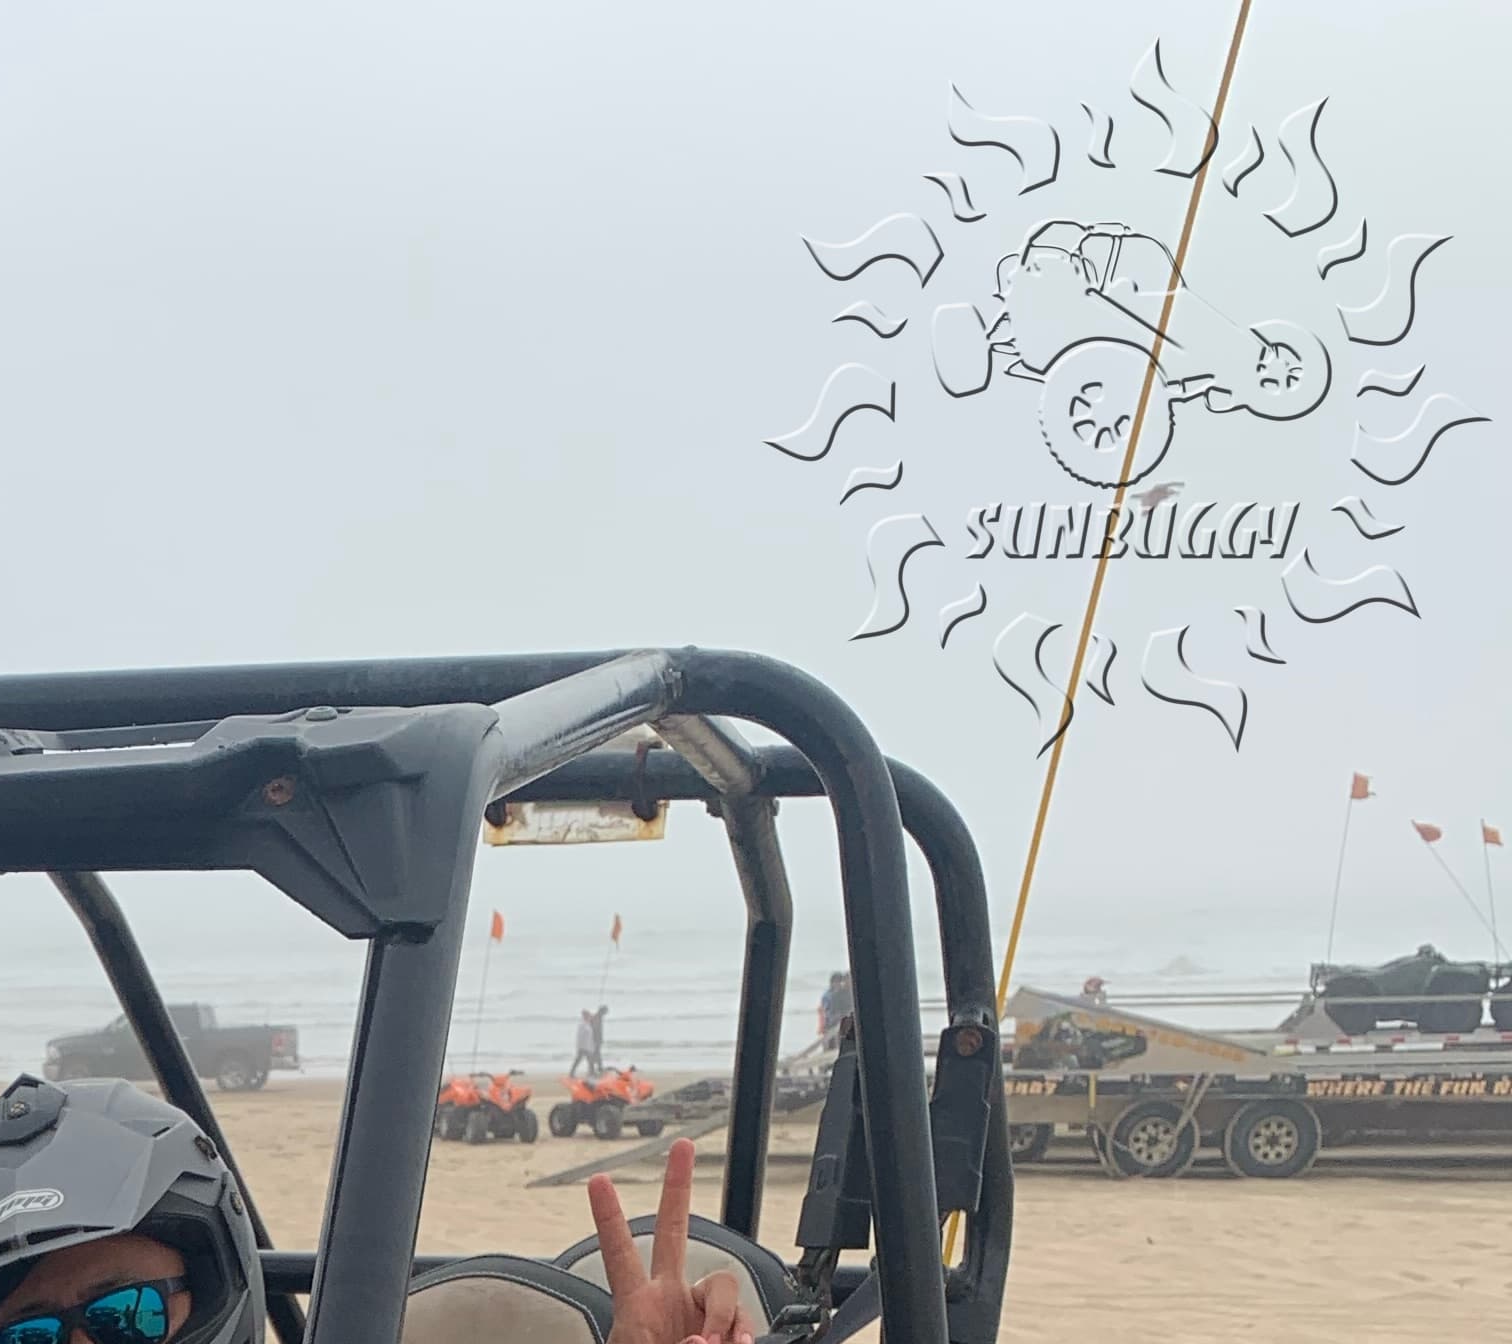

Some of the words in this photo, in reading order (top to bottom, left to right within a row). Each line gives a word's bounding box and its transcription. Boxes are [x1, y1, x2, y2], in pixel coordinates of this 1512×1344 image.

[1306, 1080, 1386, 1097] WHERE
[1393, 1080, 1434, 1097] THE
[1440, 1080, 1487, 1097] FUN
